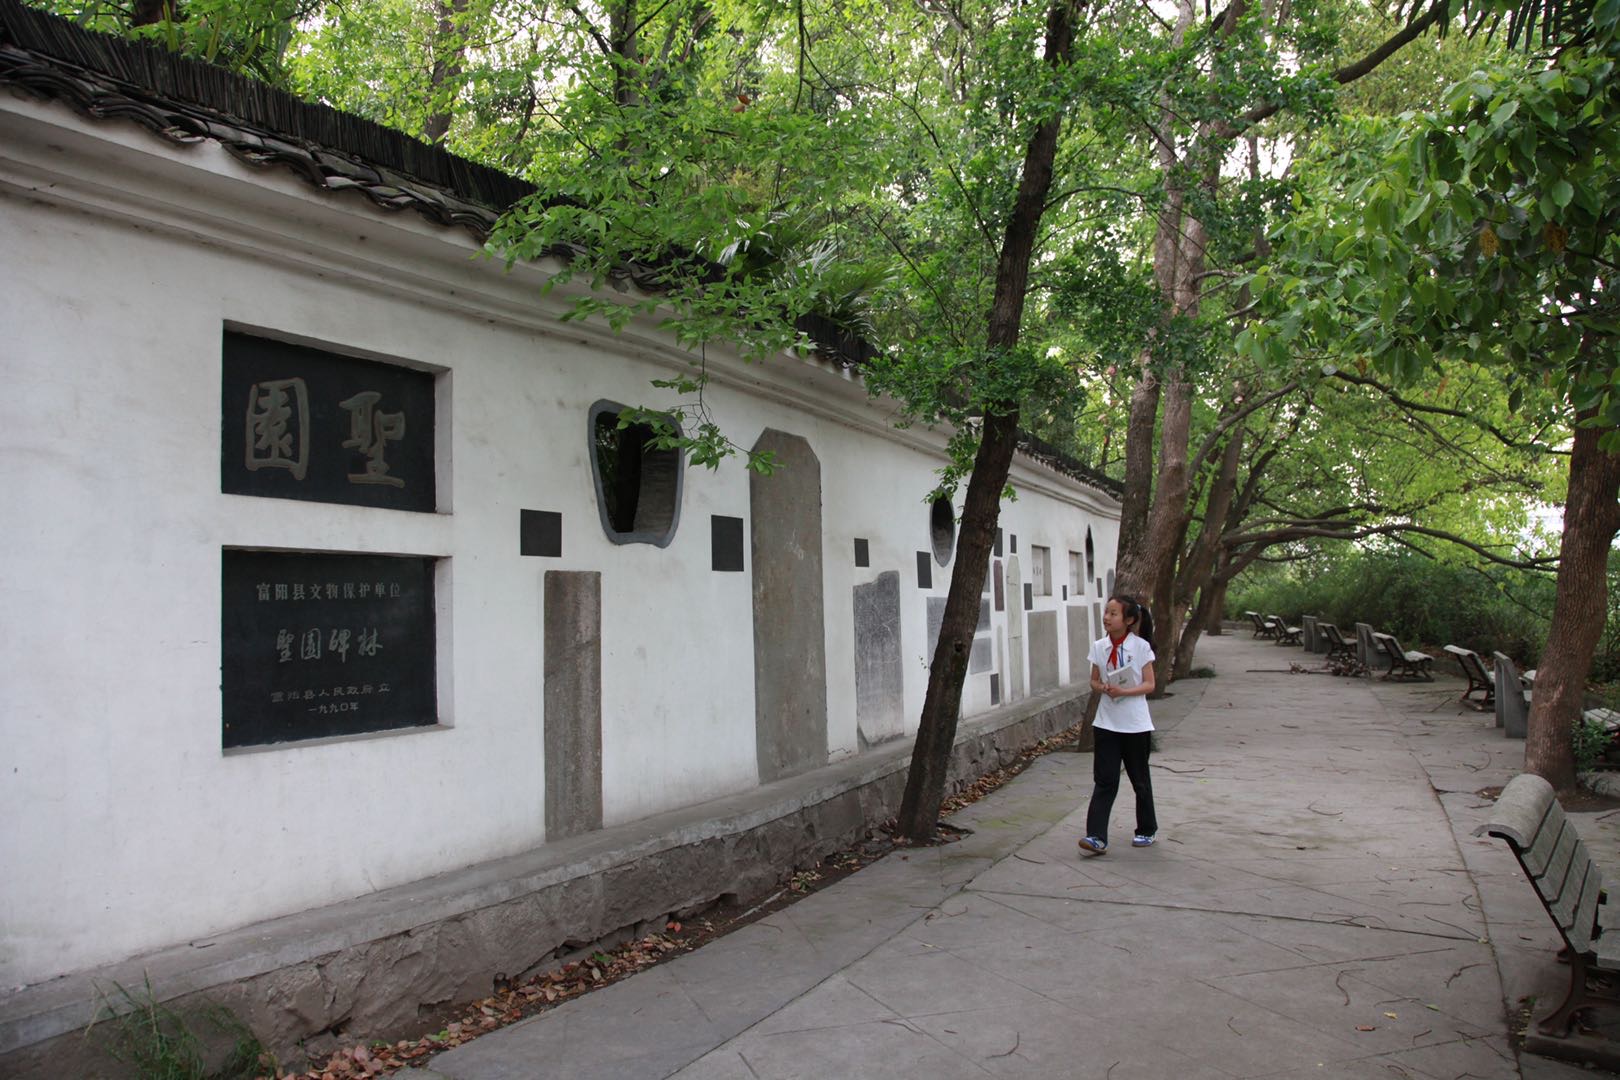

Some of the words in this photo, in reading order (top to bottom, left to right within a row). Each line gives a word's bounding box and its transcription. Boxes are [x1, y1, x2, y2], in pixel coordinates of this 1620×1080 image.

[256, 582, 401, 601] 富阳县文物保护单位
